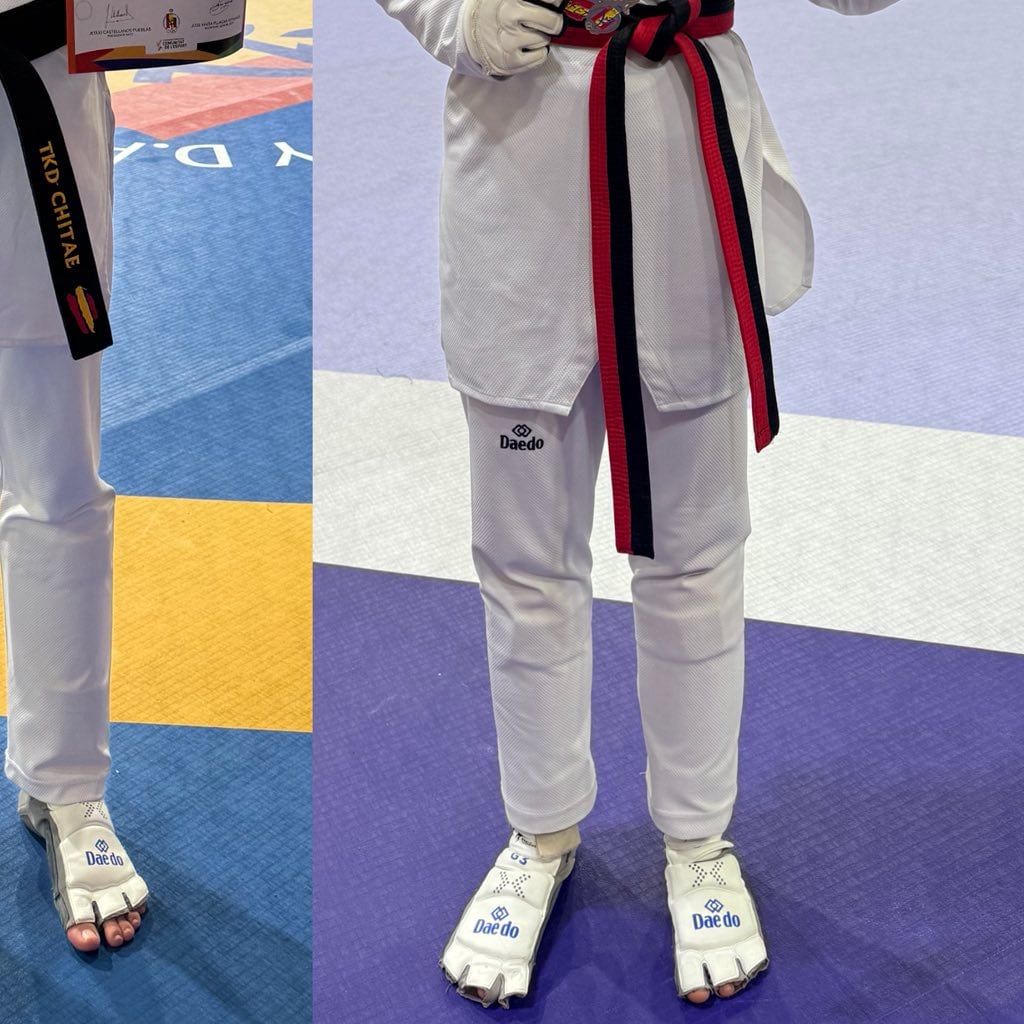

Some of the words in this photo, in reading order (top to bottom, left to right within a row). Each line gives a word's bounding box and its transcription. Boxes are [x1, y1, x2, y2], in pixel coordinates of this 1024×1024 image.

[38, 141, 60, 185] TKD
[51, 190, 81, 270] CHITAE
[499, 434, 544, 451] Daedo
[86, 850, 124, 868] Daedo
[473, 918, 520, 939] Daedo
[692, 912, 741, 930] Daedo
